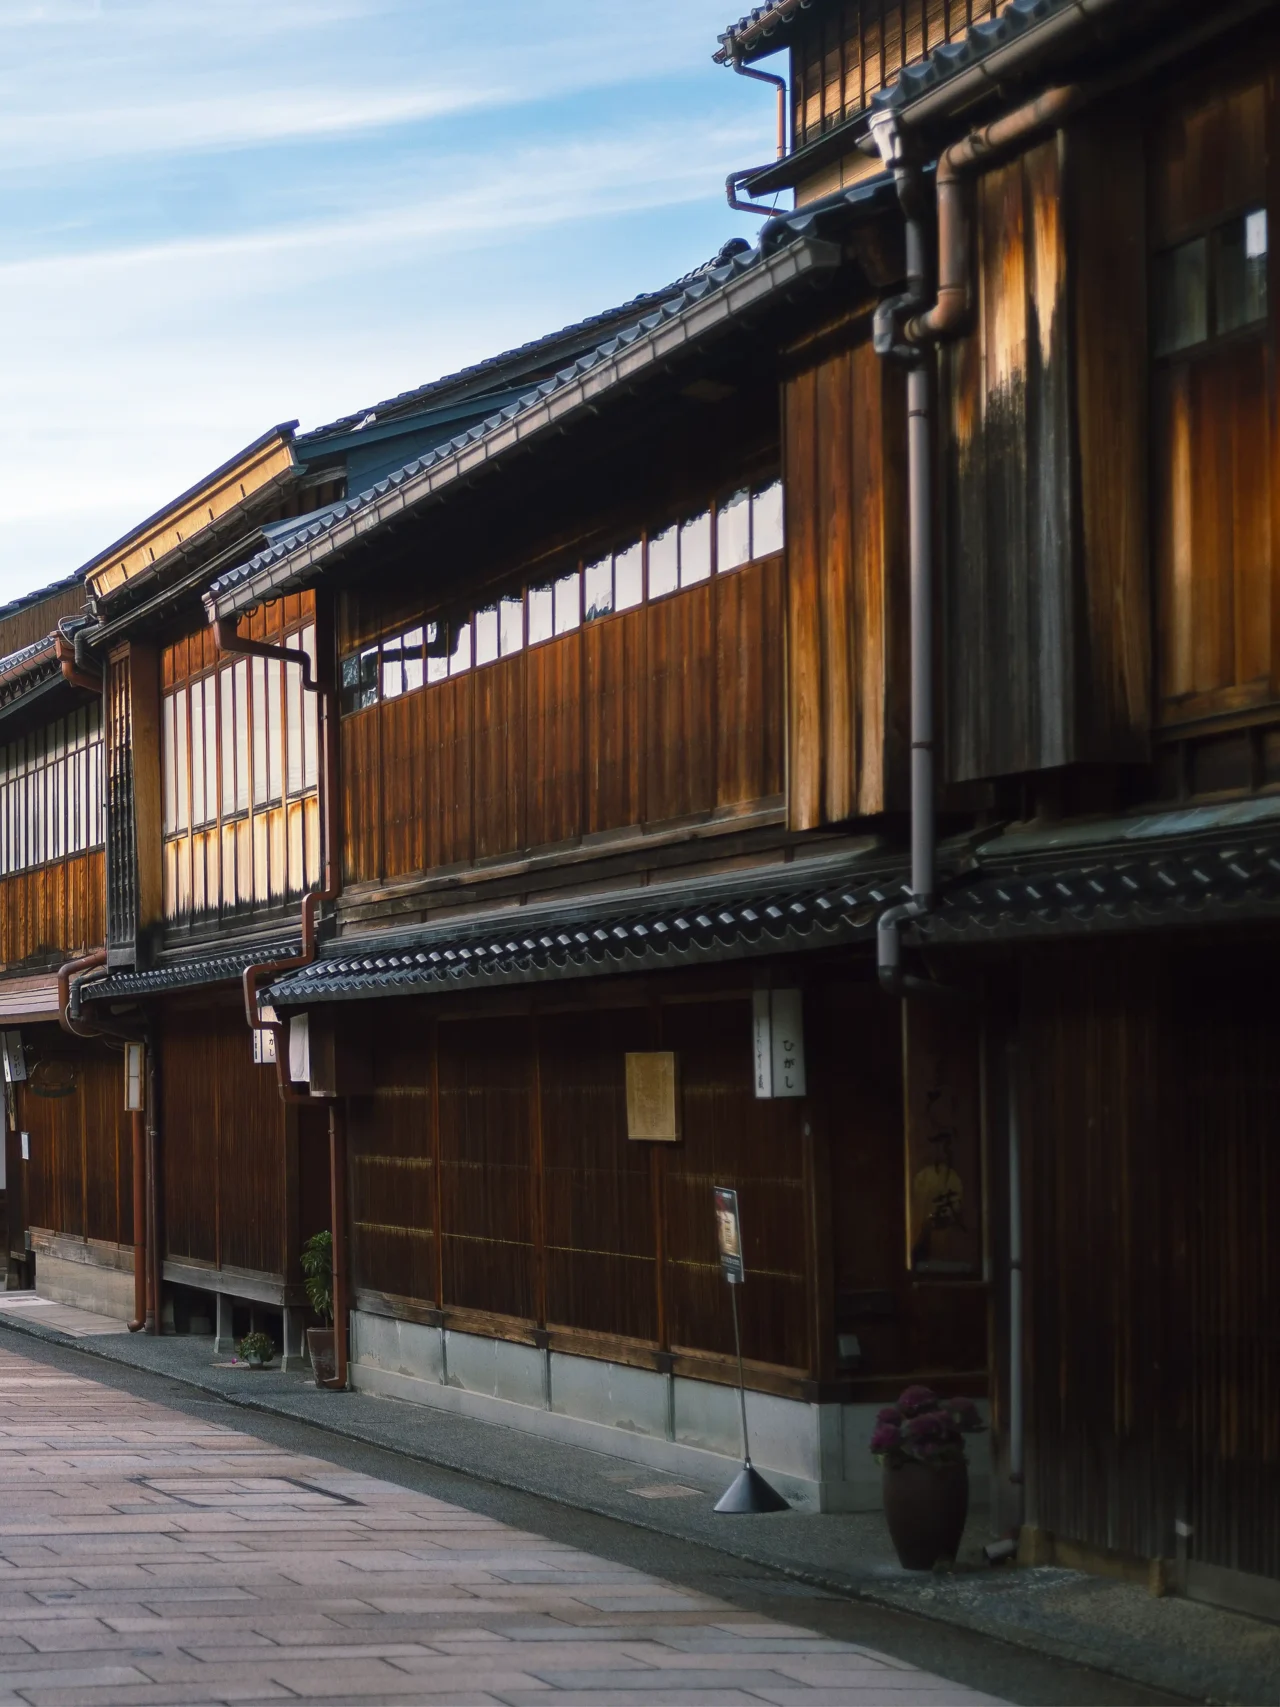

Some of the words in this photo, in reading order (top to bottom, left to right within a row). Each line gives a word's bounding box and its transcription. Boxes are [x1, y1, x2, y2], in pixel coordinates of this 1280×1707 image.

[13, 1054, 21, 1076] ひがし
[782, 1040, 796, 1089] ひがし
